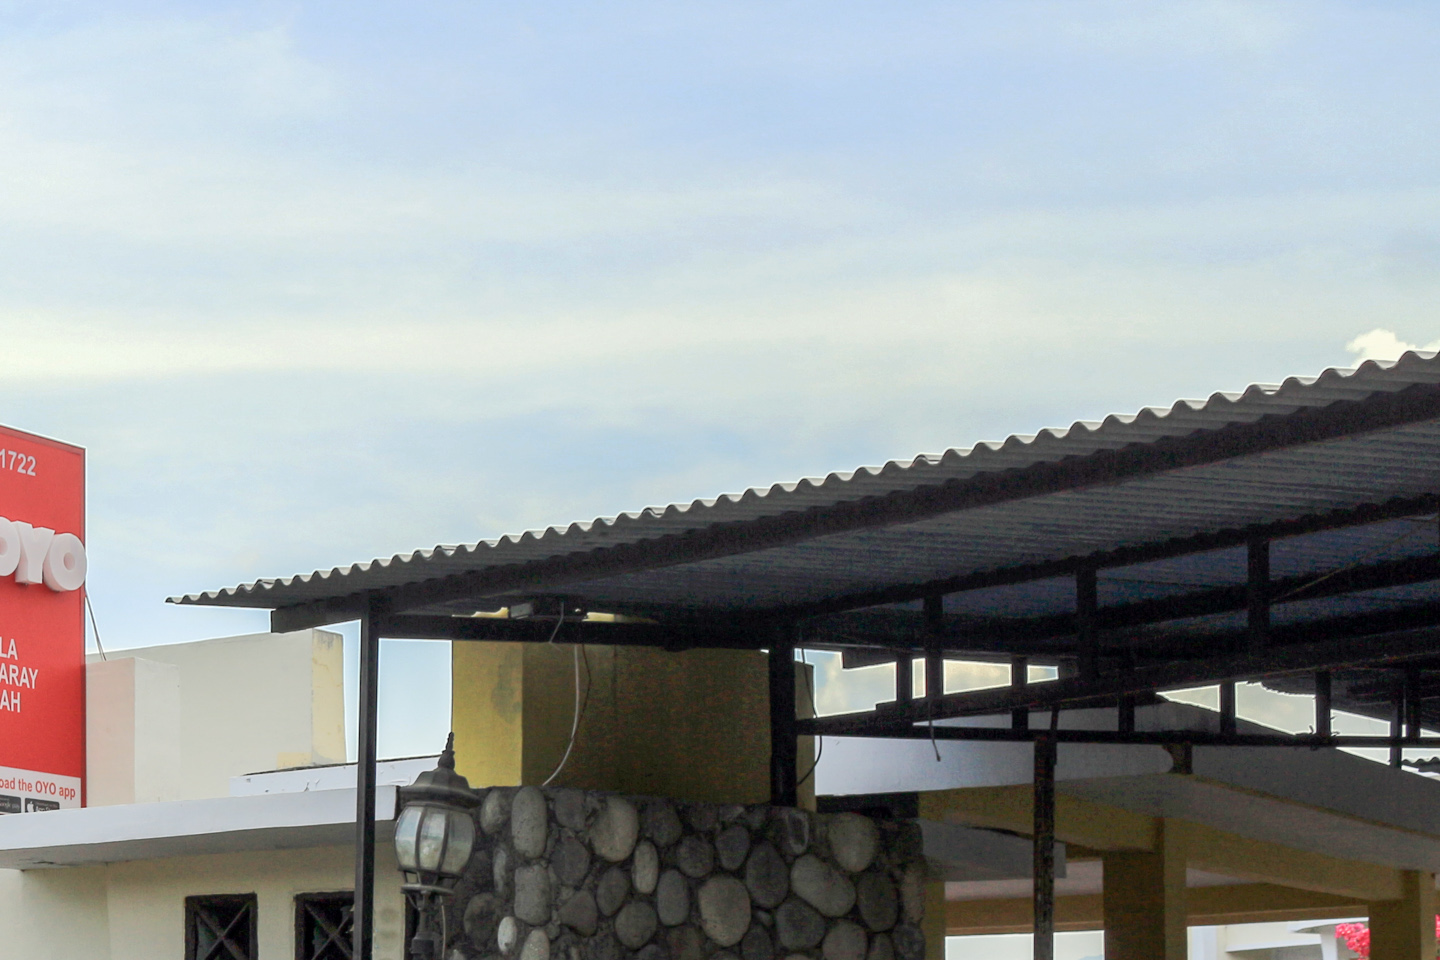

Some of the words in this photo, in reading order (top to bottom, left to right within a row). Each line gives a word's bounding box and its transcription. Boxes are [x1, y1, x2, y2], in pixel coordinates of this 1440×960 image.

[18, 778, 33, 793] the
[35, 781, 57, 796] OYO
[59, 786, 76, 800] app
